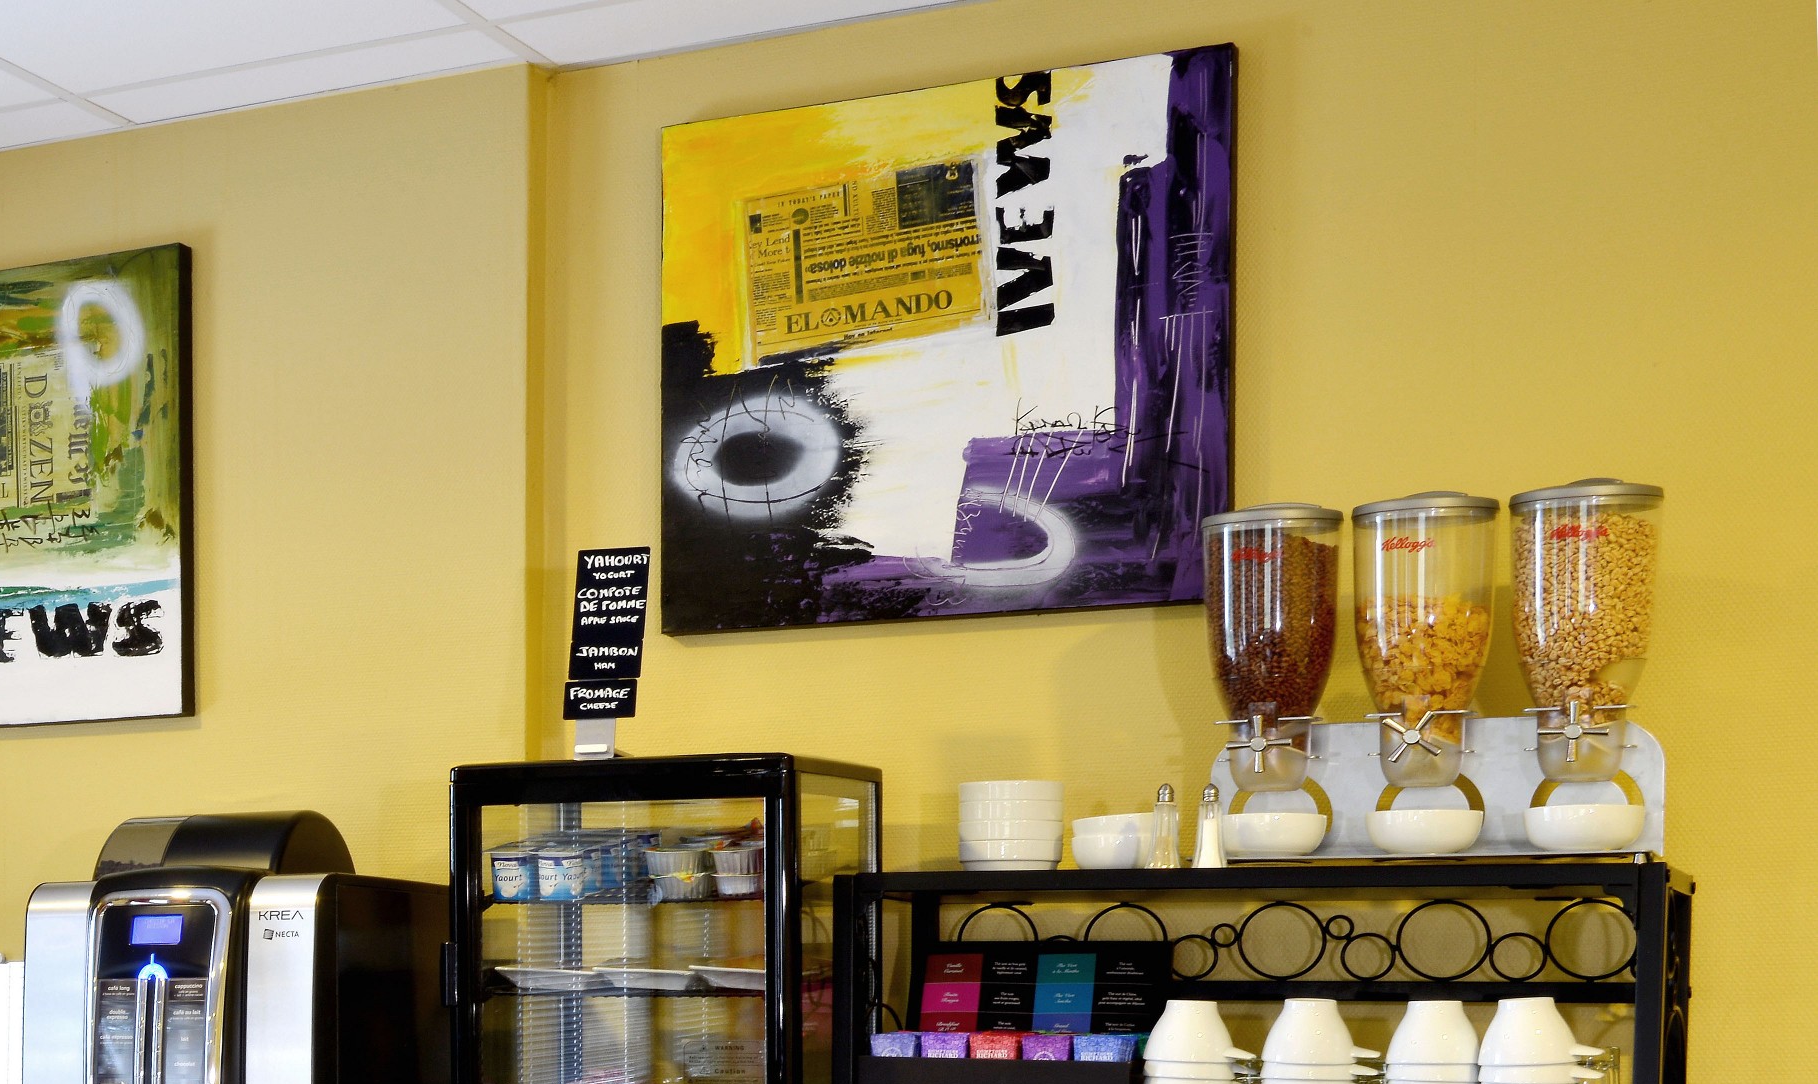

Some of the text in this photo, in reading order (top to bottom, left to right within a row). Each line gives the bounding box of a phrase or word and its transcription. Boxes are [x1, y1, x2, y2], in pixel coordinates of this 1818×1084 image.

[996, 71, 1054, 336] NEWS
[887, 248, 898, 262] di
[900, 242, 925, 259] fuga
[849, 251, 885, 267] notizie
[784, 289, 953, 334] EL MANDO
[593, 570, 635, 580] YOGURT
[577, 586, 642, 599] COMPOTE
[580, 600, 598, 612] DE
[581, 615, 640, 626] APPLE SAUCE
[576, 646, 639, 657] JAMBON
[594, 662, 616, 670] HAM
[570, 687, 631, 700] FROMAGE
[580, 702, 619, 711] CHEESE
[494, 873, 524, 882] Yaourt
[540, 873, 558, 881] ourt
